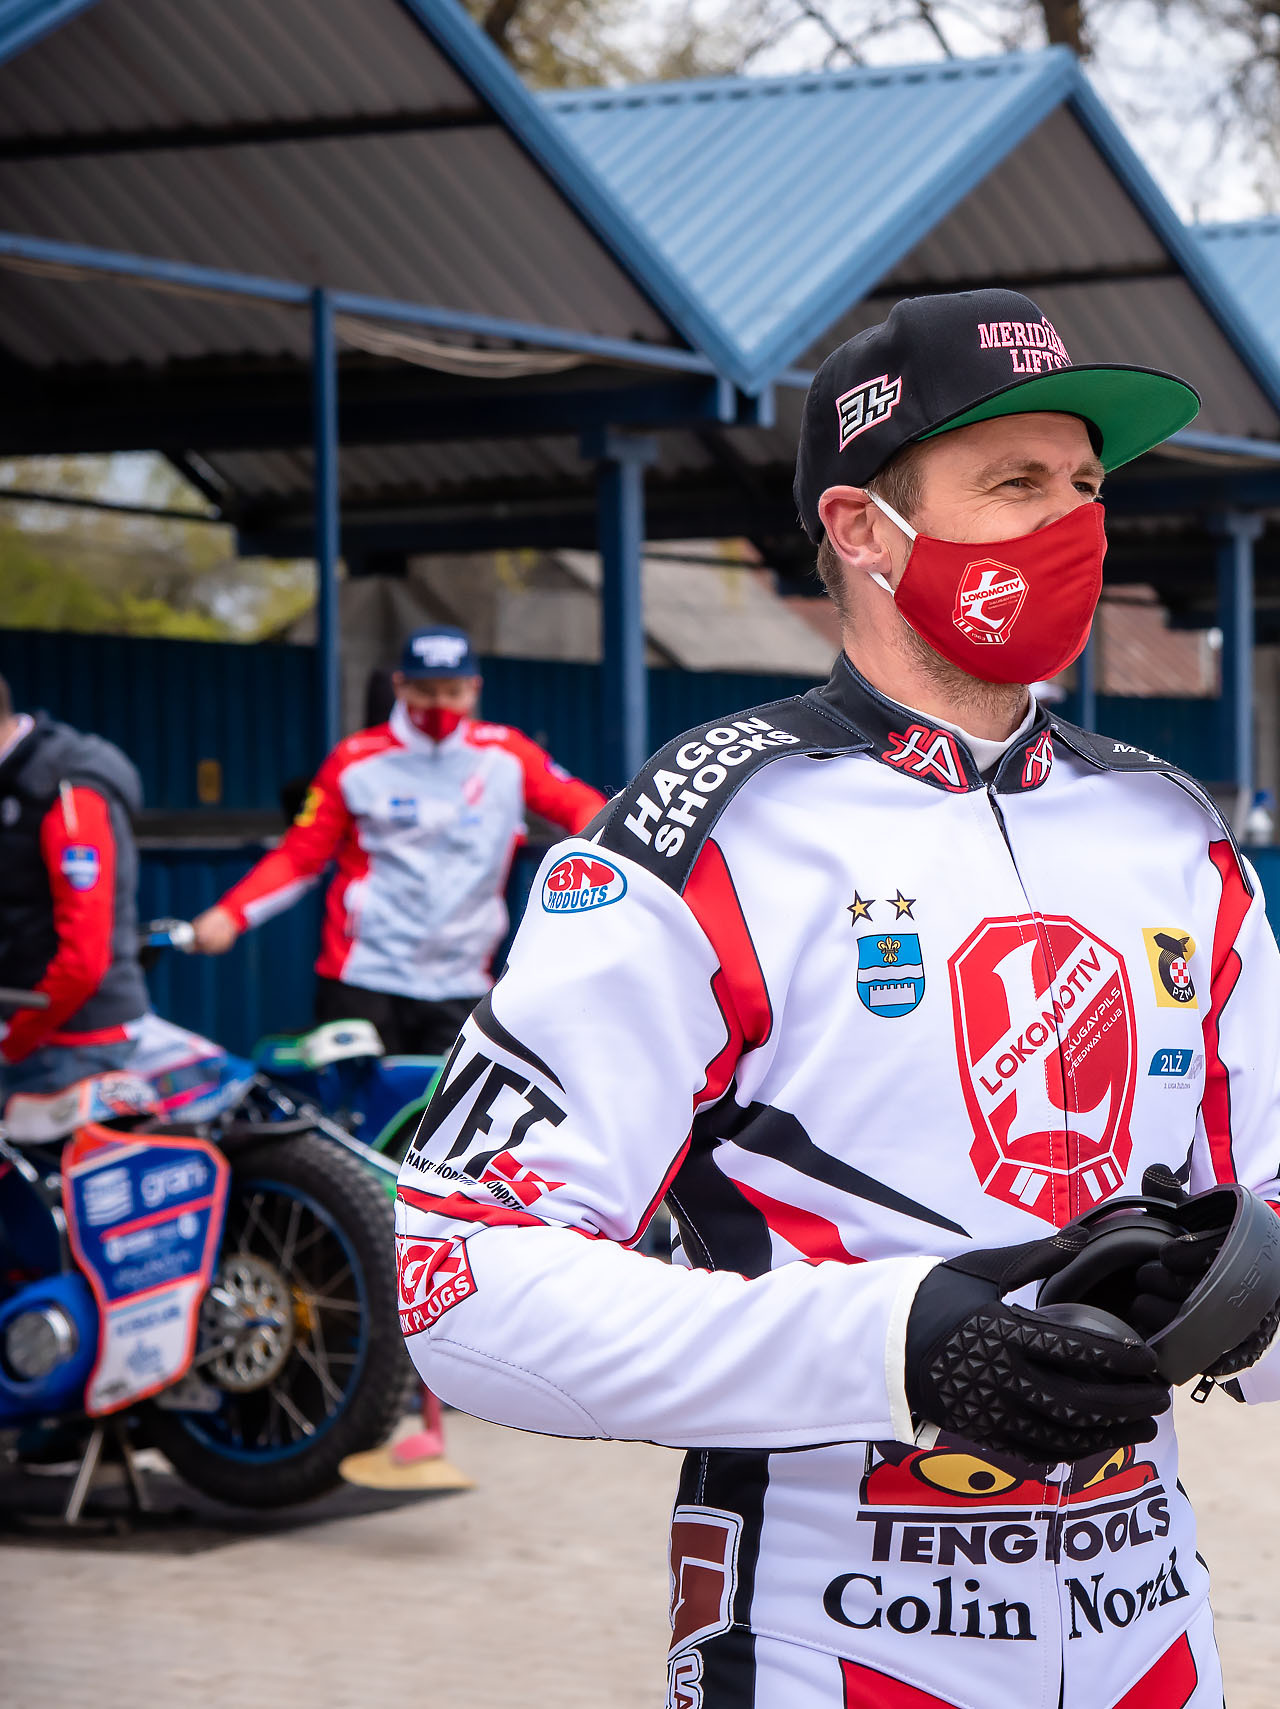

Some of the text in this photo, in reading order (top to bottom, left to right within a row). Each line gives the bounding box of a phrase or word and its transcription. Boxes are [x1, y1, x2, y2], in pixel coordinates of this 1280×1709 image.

[962, 580, 1020, 603] LOKOMOTIV
[623, 716, 774, 845] HAGON
[655, 730, 801, 858] SHOCKS
[547, 884, 609, 909] PRODUCTS
[978, 945, 1102, 1096] LOKOMOTIV
[1102, 1008, 1123, 1033] CLUB
[1171, 986, 1194, 1002] PZM
[1063, 986, 1121, 1062] DAUGAVPILS
[1160, 1050, 1184, 1073] 2LŻ
[412, 1275, 471, 1332] PLUGS
[823, 1572, 1038, 1641] Colin
